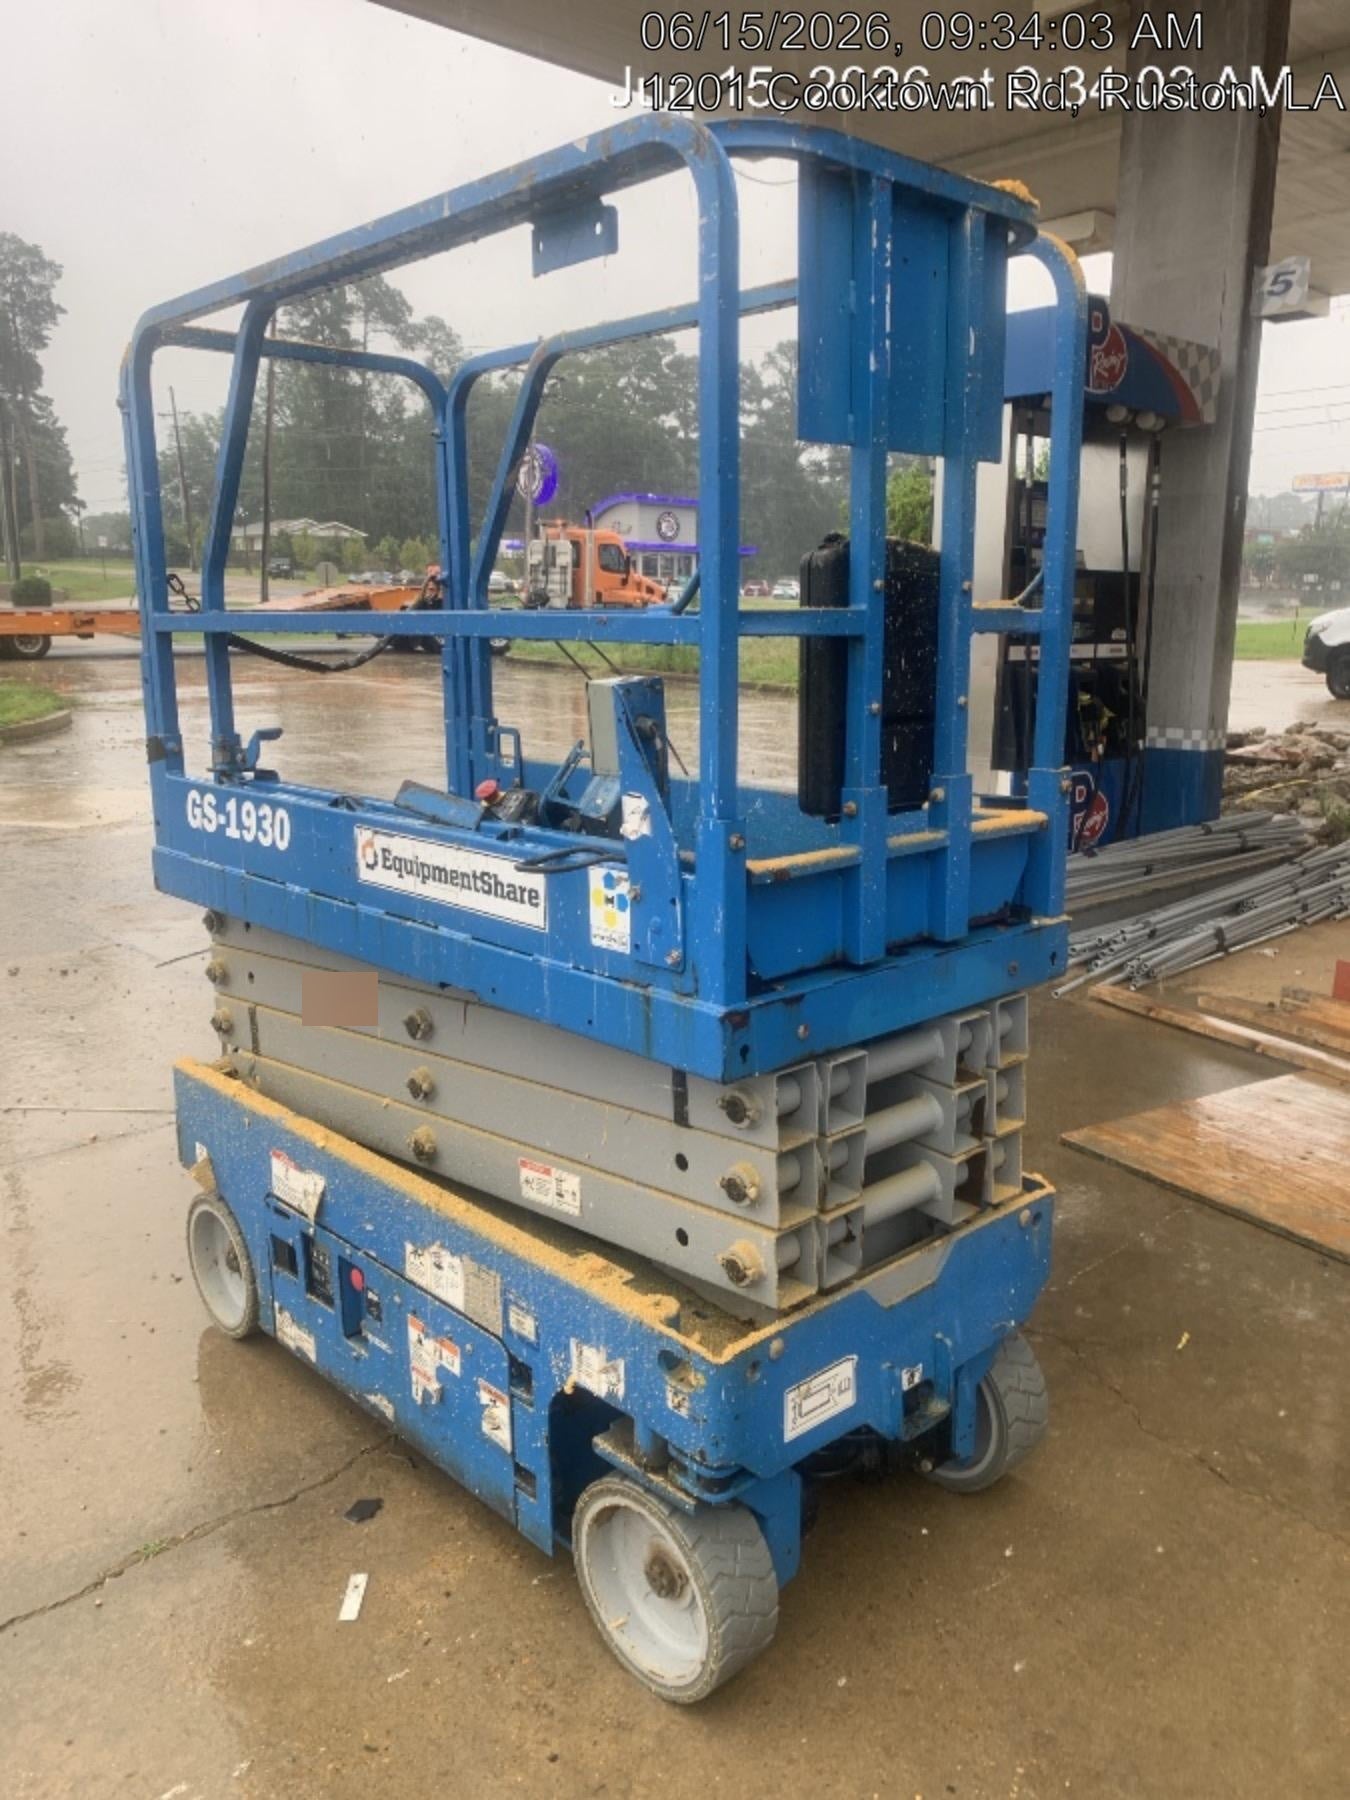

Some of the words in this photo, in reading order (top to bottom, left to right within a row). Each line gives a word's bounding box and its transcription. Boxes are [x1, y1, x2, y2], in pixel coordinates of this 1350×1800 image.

[1267, 269, 1297, 297] 5
[186, 789, 291, 851] GS-1930
[381, 847, 540, 908] EquipmentShare
